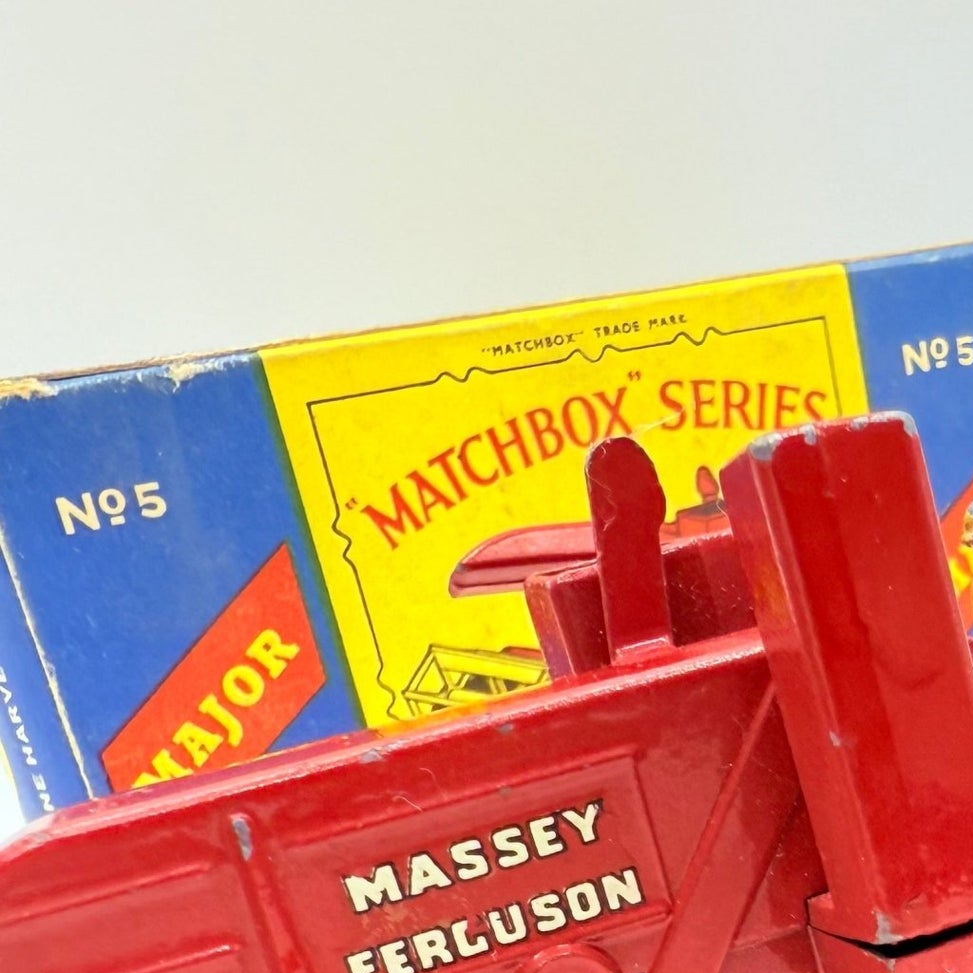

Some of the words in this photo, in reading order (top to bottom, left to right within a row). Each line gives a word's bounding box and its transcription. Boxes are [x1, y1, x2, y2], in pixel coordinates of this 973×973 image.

[593, 320, 640, 338] TRADE
[657, 379, 829, 432] SERIES
[134, 481, 167, 518] 5
[342, 799, 604, 914] MASSEY
